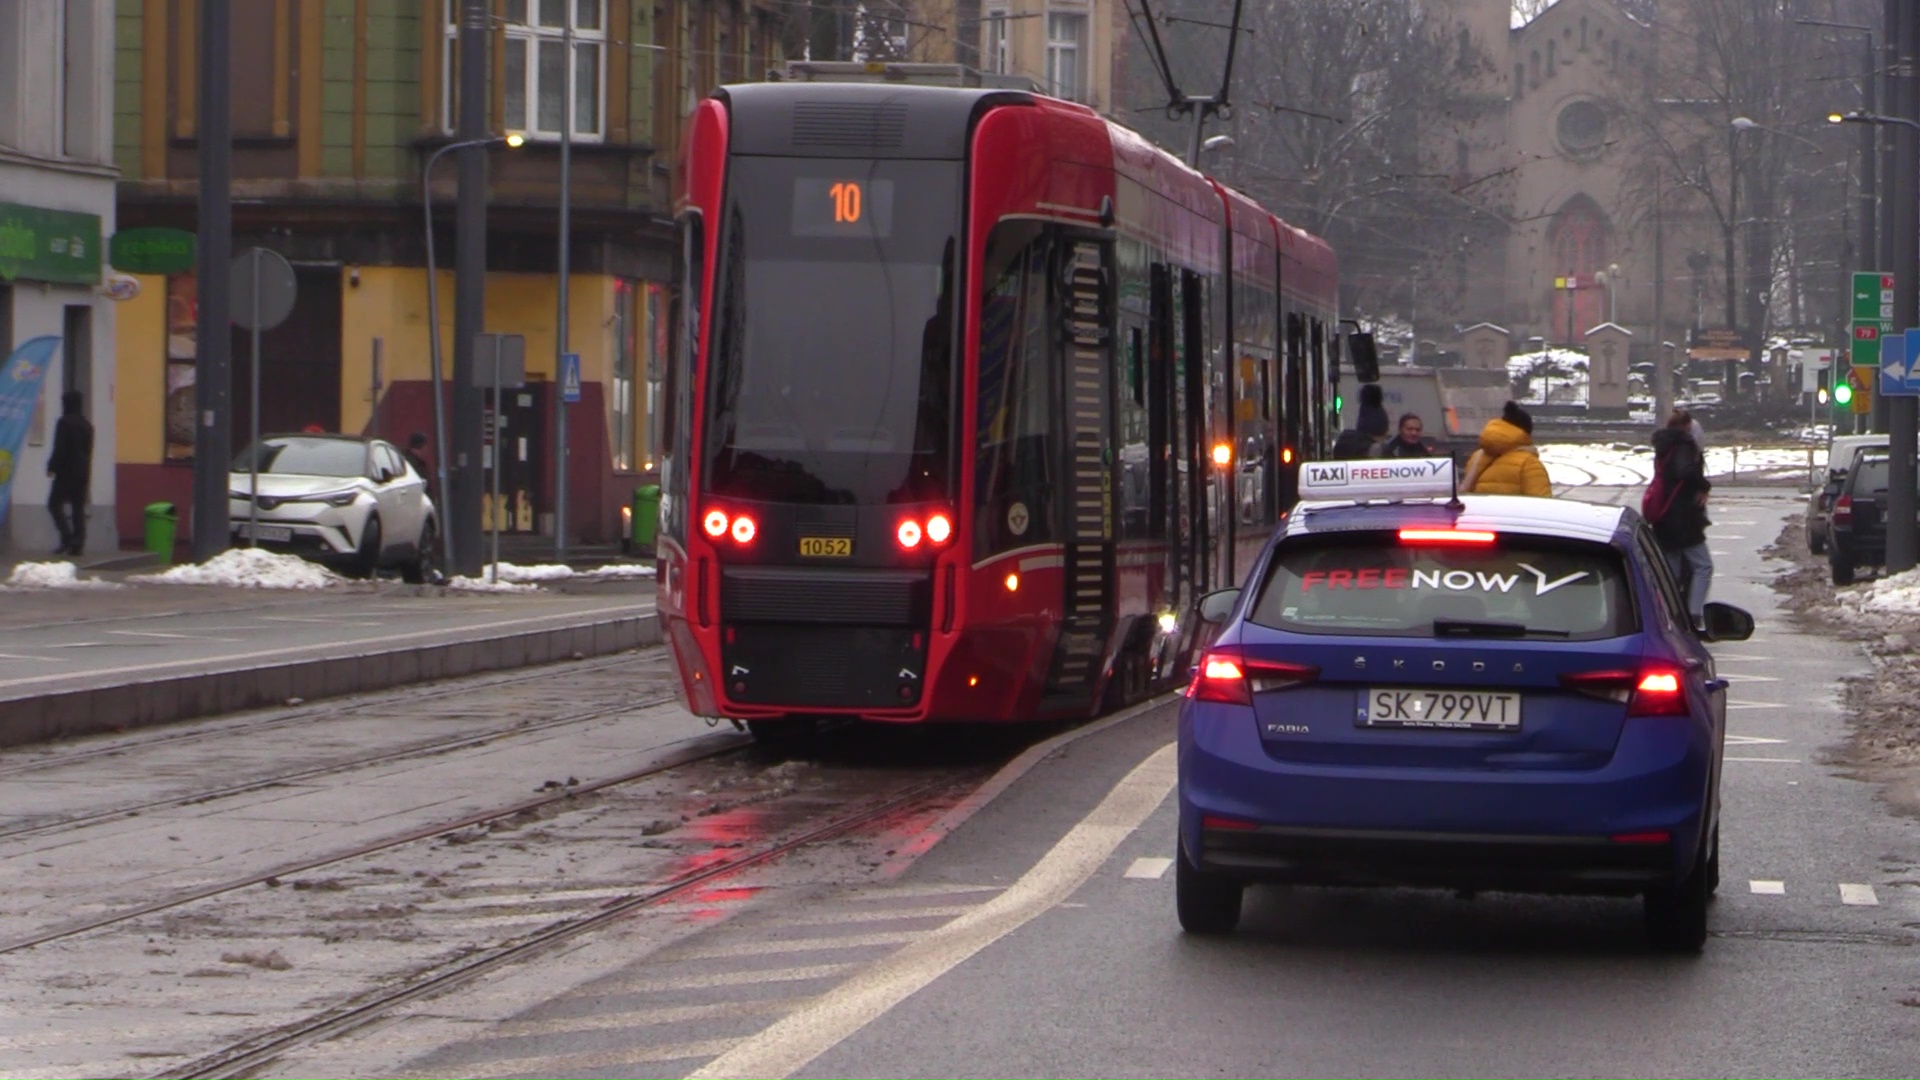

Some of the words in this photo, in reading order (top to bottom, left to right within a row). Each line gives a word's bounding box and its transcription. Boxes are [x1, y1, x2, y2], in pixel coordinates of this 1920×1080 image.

[830, 182, 860, 222] 10
[1861, 329, 1871, 338] 79
[1311, 467, 1344, 481] TAXI
[803, 540, 847, 555] 1052
[1357, 708, 1367, 717] PL
[1376, 692, 1411, 719] SK
[1424, 693, 1512, 722] 799VT
[1267, 724, 1310, 733] FABIA
